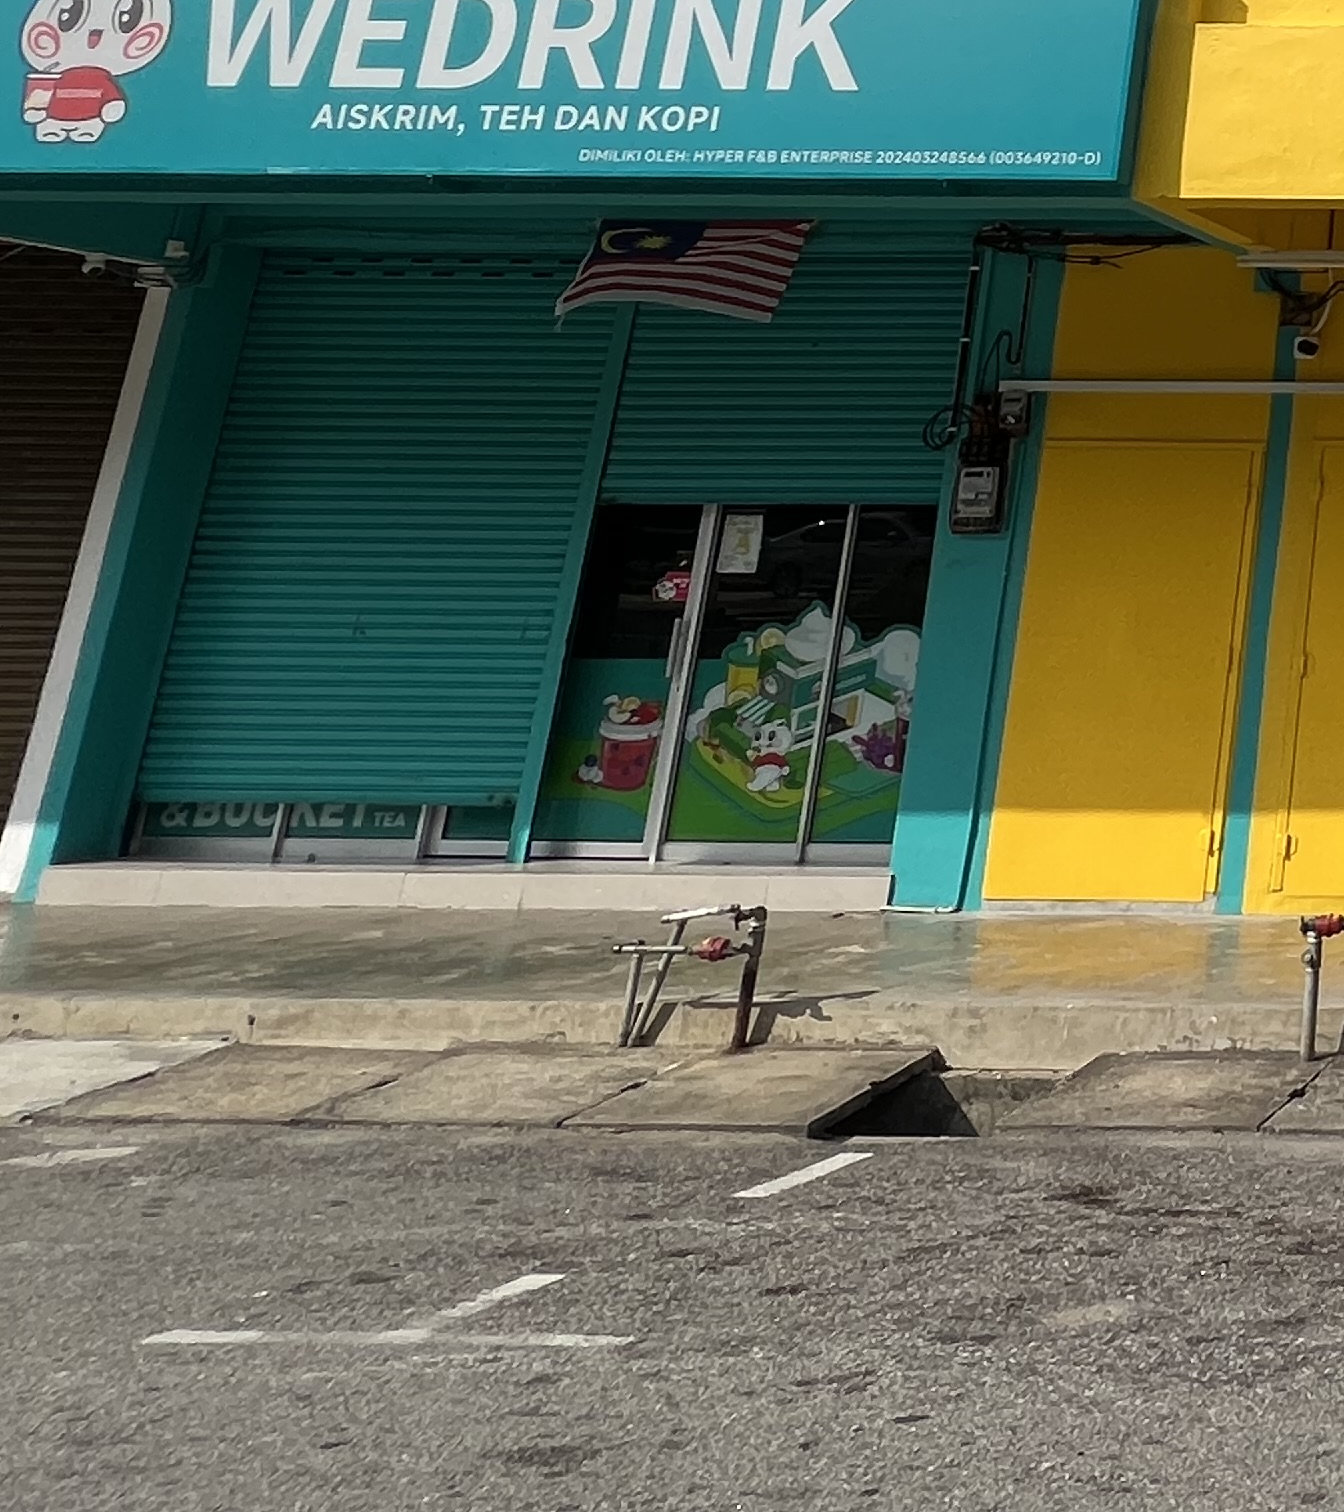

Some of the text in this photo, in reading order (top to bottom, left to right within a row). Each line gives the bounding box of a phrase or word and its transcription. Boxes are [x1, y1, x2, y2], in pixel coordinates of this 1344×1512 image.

[310, 104, 721, 136] AISKRIM, TEH DAN KOPI
[578, 148, 641, 163] DIMILIKI
[692, 149, 744, 163] HYPER
[780, 150, 873, 164] ENTERPRISE
[373, 811, 406, 828] TEA
